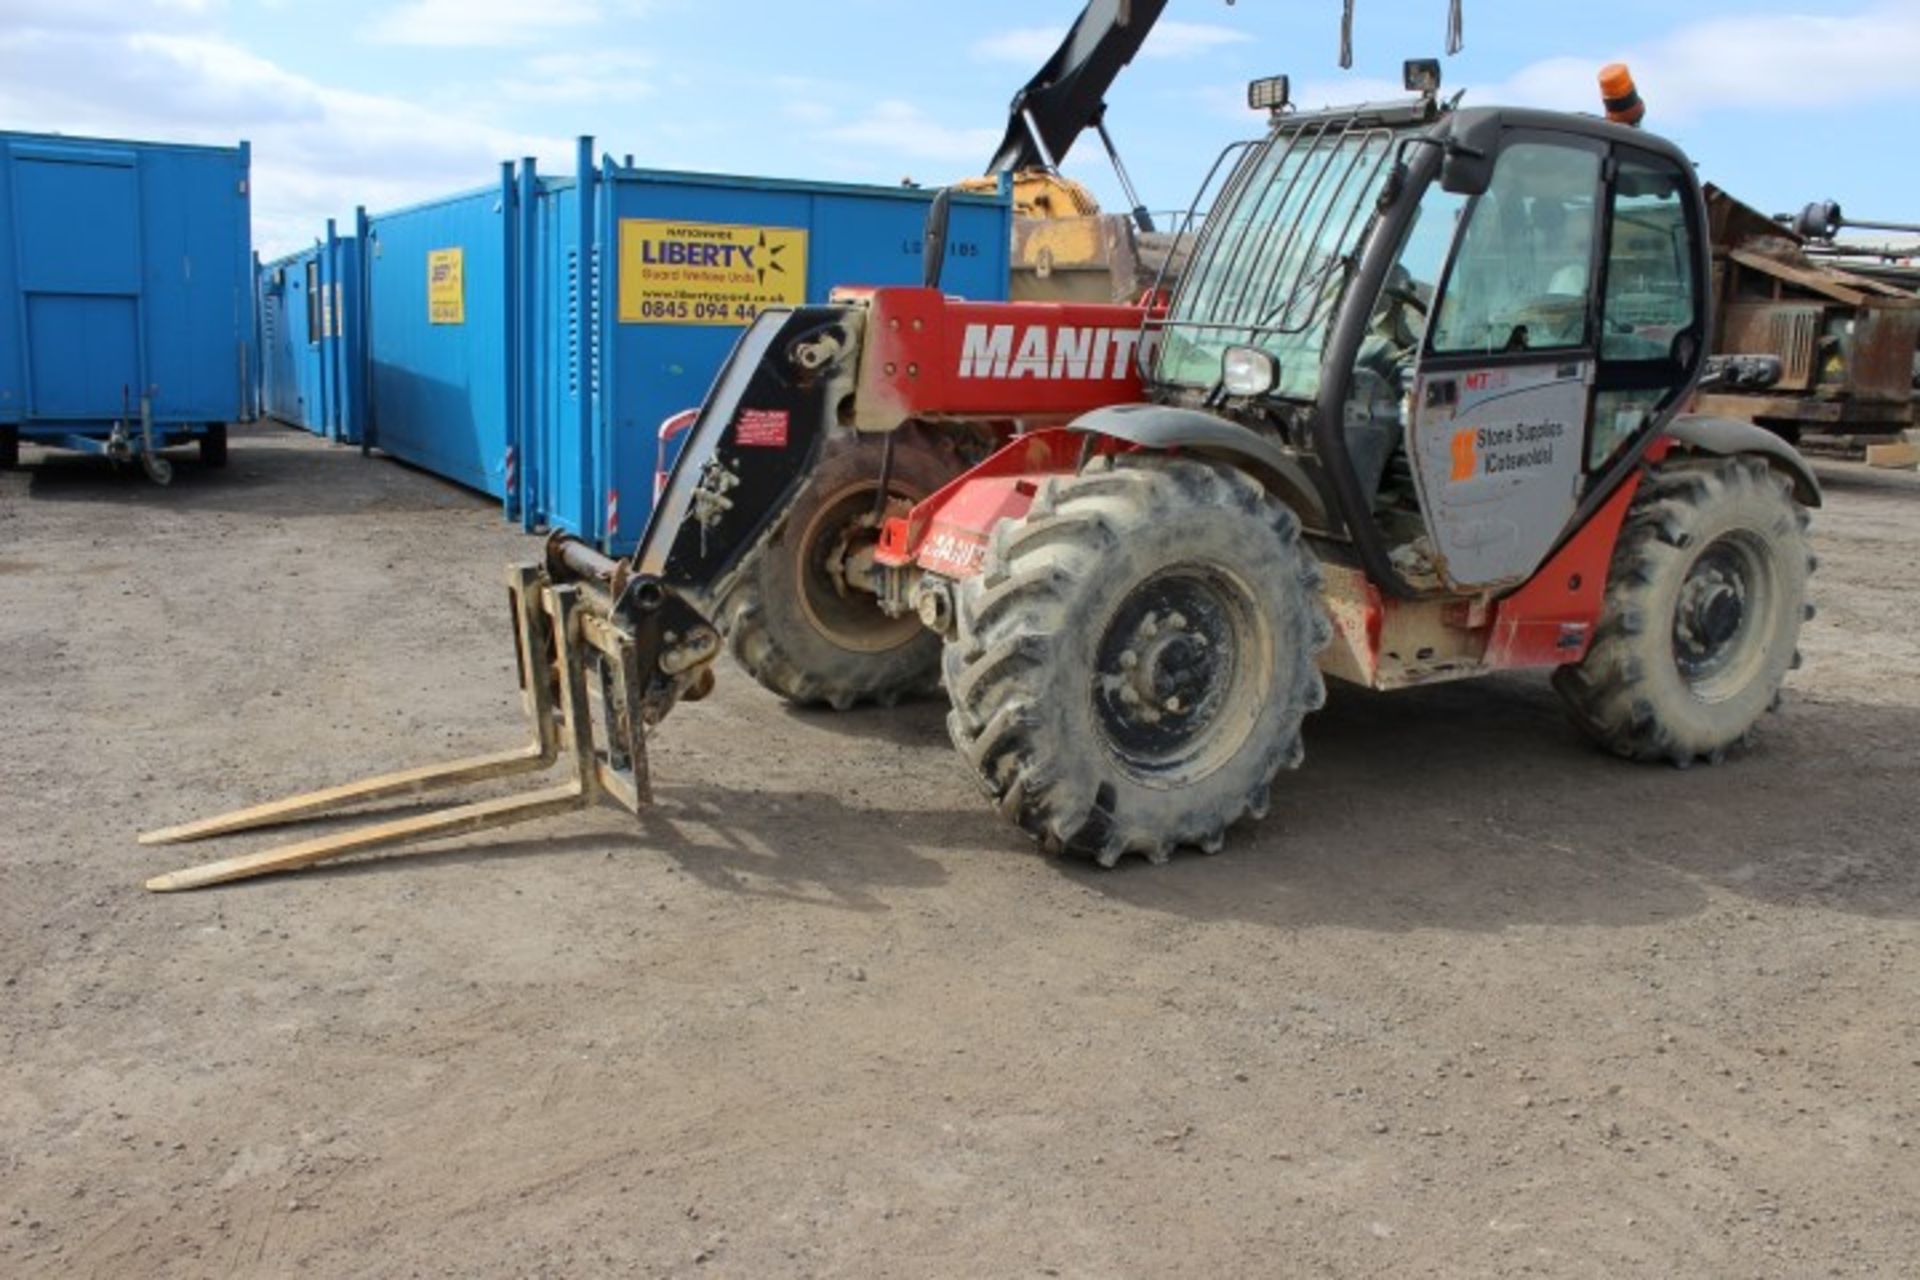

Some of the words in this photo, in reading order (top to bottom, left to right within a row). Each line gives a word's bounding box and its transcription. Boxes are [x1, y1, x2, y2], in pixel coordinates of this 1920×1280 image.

[643, 241, 754, 268] LIBERTY
[641, 300, 688, 318] 0845
[694, 302, 728, 319] 094
[1477, 428, 1512, 448] Stone
[1516, 419, 1563, 443] Supplies
